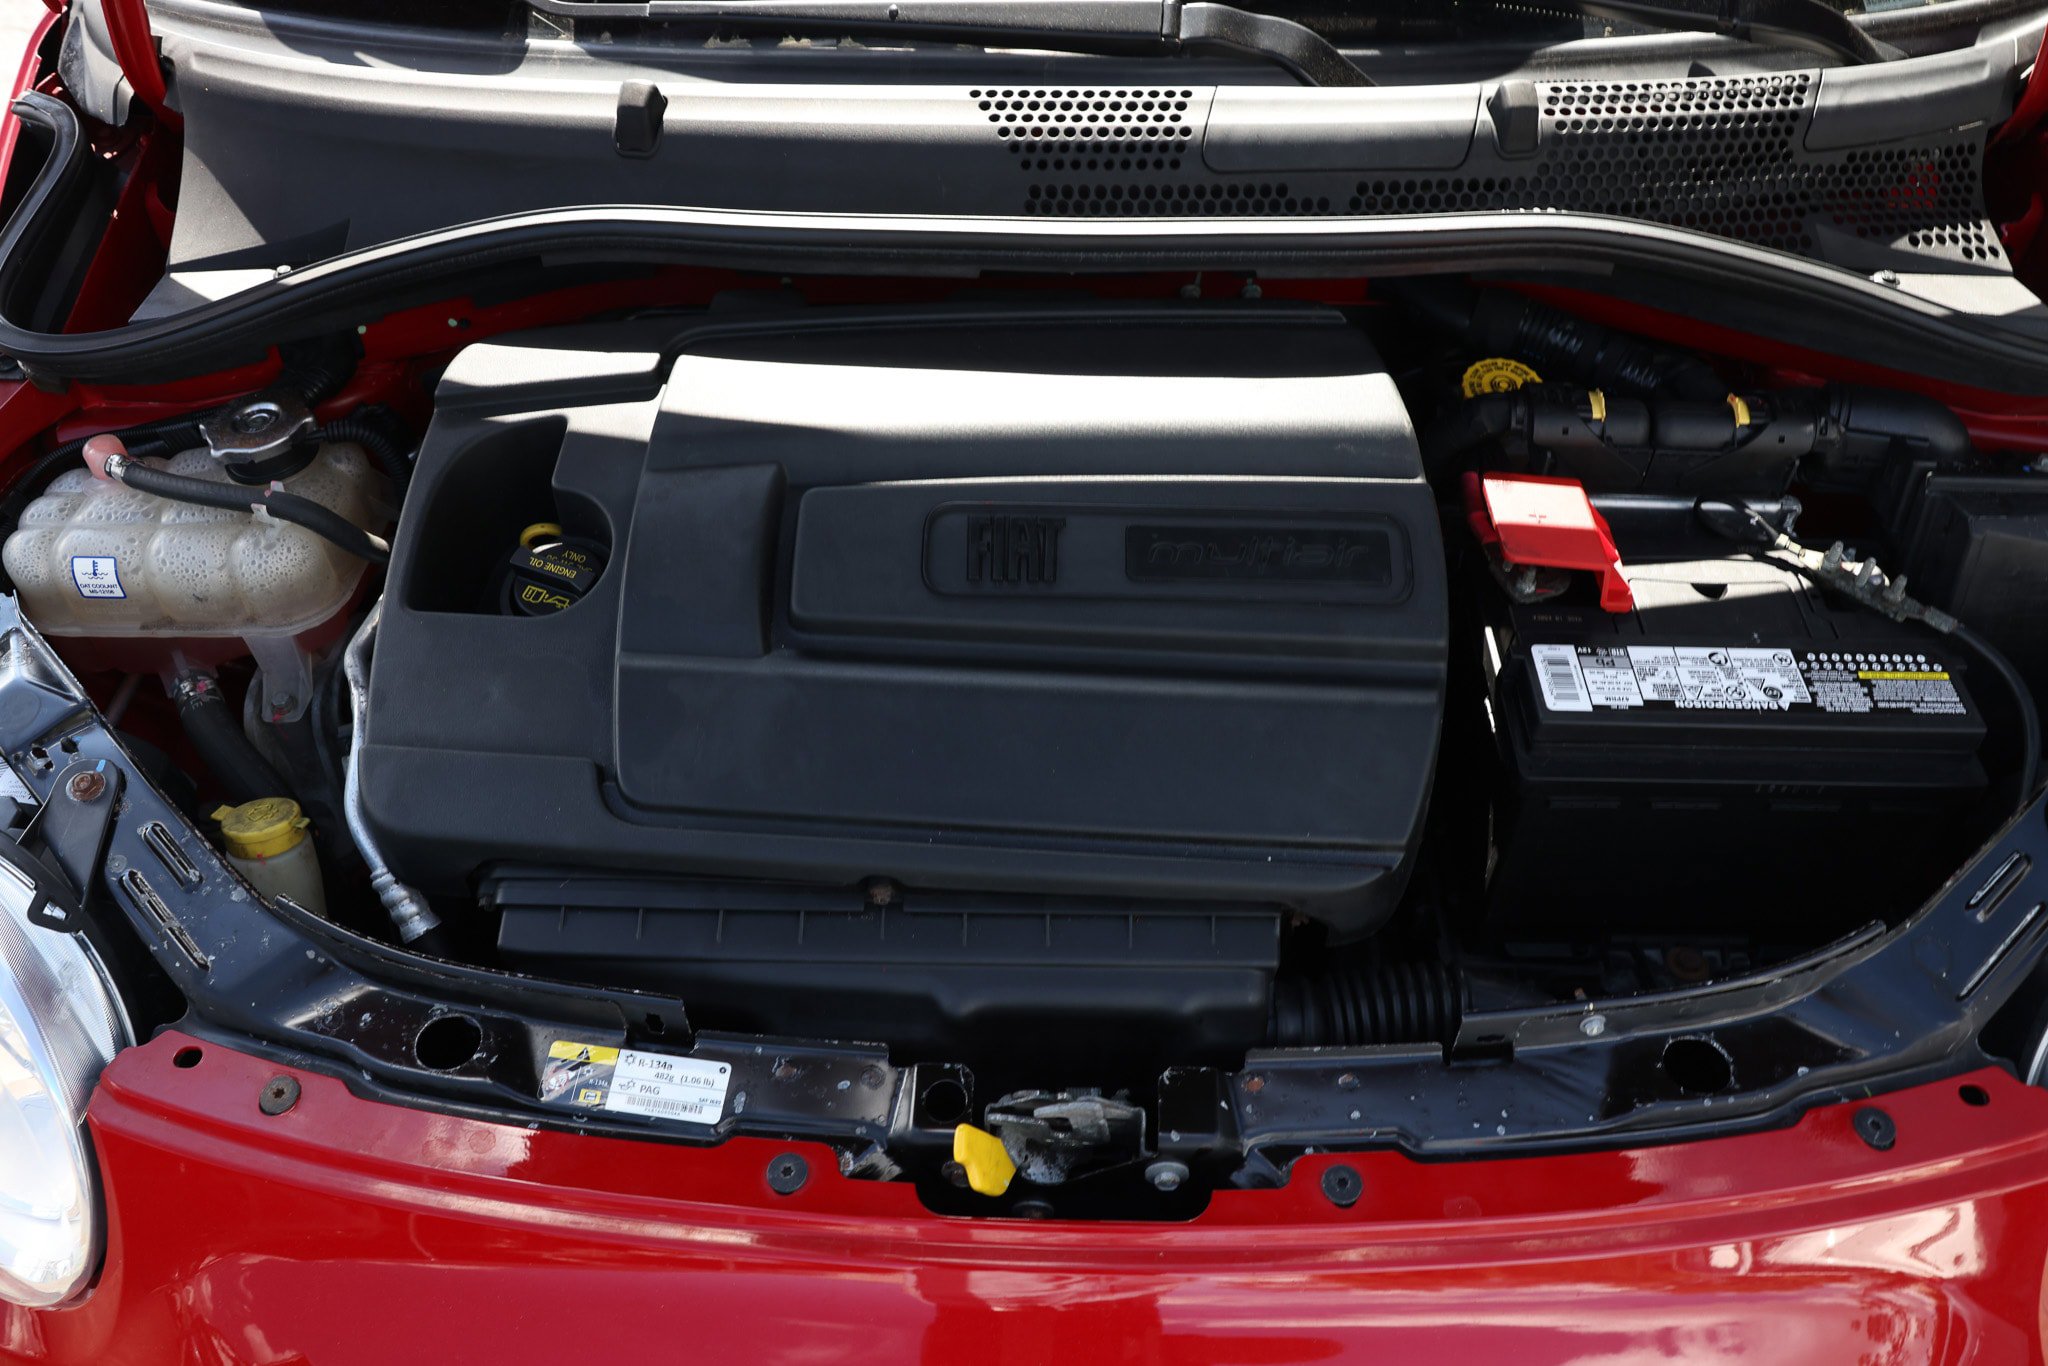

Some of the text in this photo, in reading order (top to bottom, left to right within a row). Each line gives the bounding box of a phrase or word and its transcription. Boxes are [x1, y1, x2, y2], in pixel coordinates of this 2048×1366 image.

[966, 514, 1370, 583] FIAT multiair
[529, 557, 544, 568] OIL
[562, 550, 586, 563] ONLY
[544, 562, 577, 579] ENGINE
[1675, 700, 1779, 711] DANGER/POISON
[638, 1058, 673, 1071] R-134a
[654, 1072, 715, 1088] 482g (1.06 lb)
[639, 1084, 661, 1095] PAG
